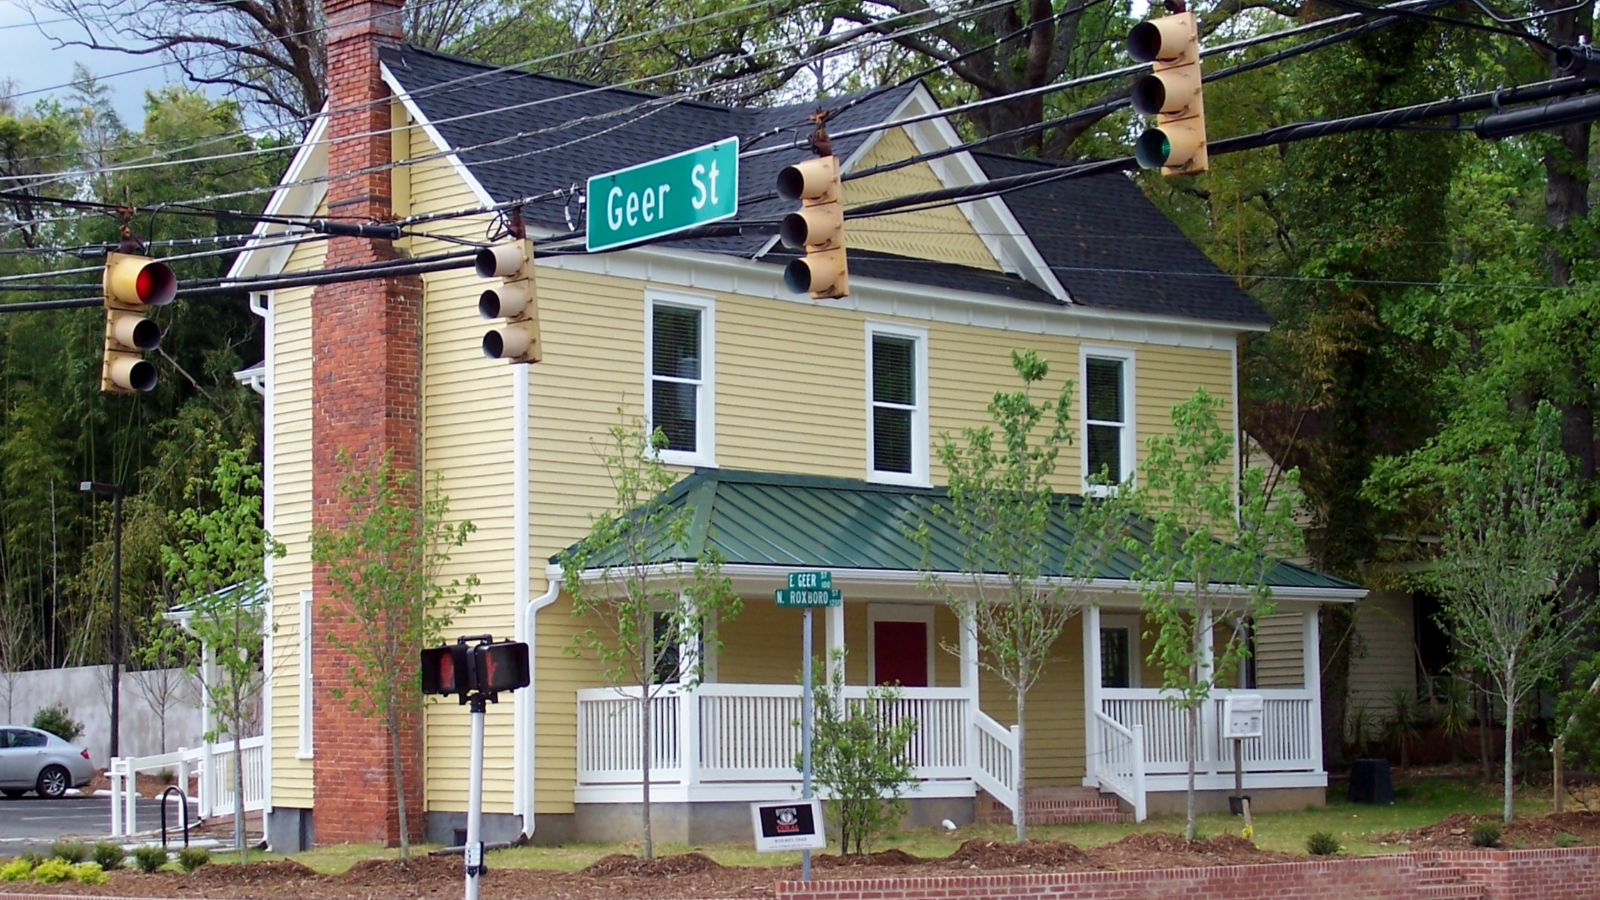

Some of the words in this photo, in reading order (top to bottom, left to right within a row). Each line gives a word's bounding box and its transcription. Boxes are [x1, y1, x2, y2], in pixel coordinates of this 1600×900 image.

[607, 184, 671, 231] Geer
[691, 158, 719, 210] St
[789, 574, 795, 588] E
[798, 574, 816, 588] GEER
[820, 571, 827, 579] ST
[777, 591, 785, 604] N.
[790, 591, 828, 604] ROXBORO
[832, 589, 839, 597] ST
